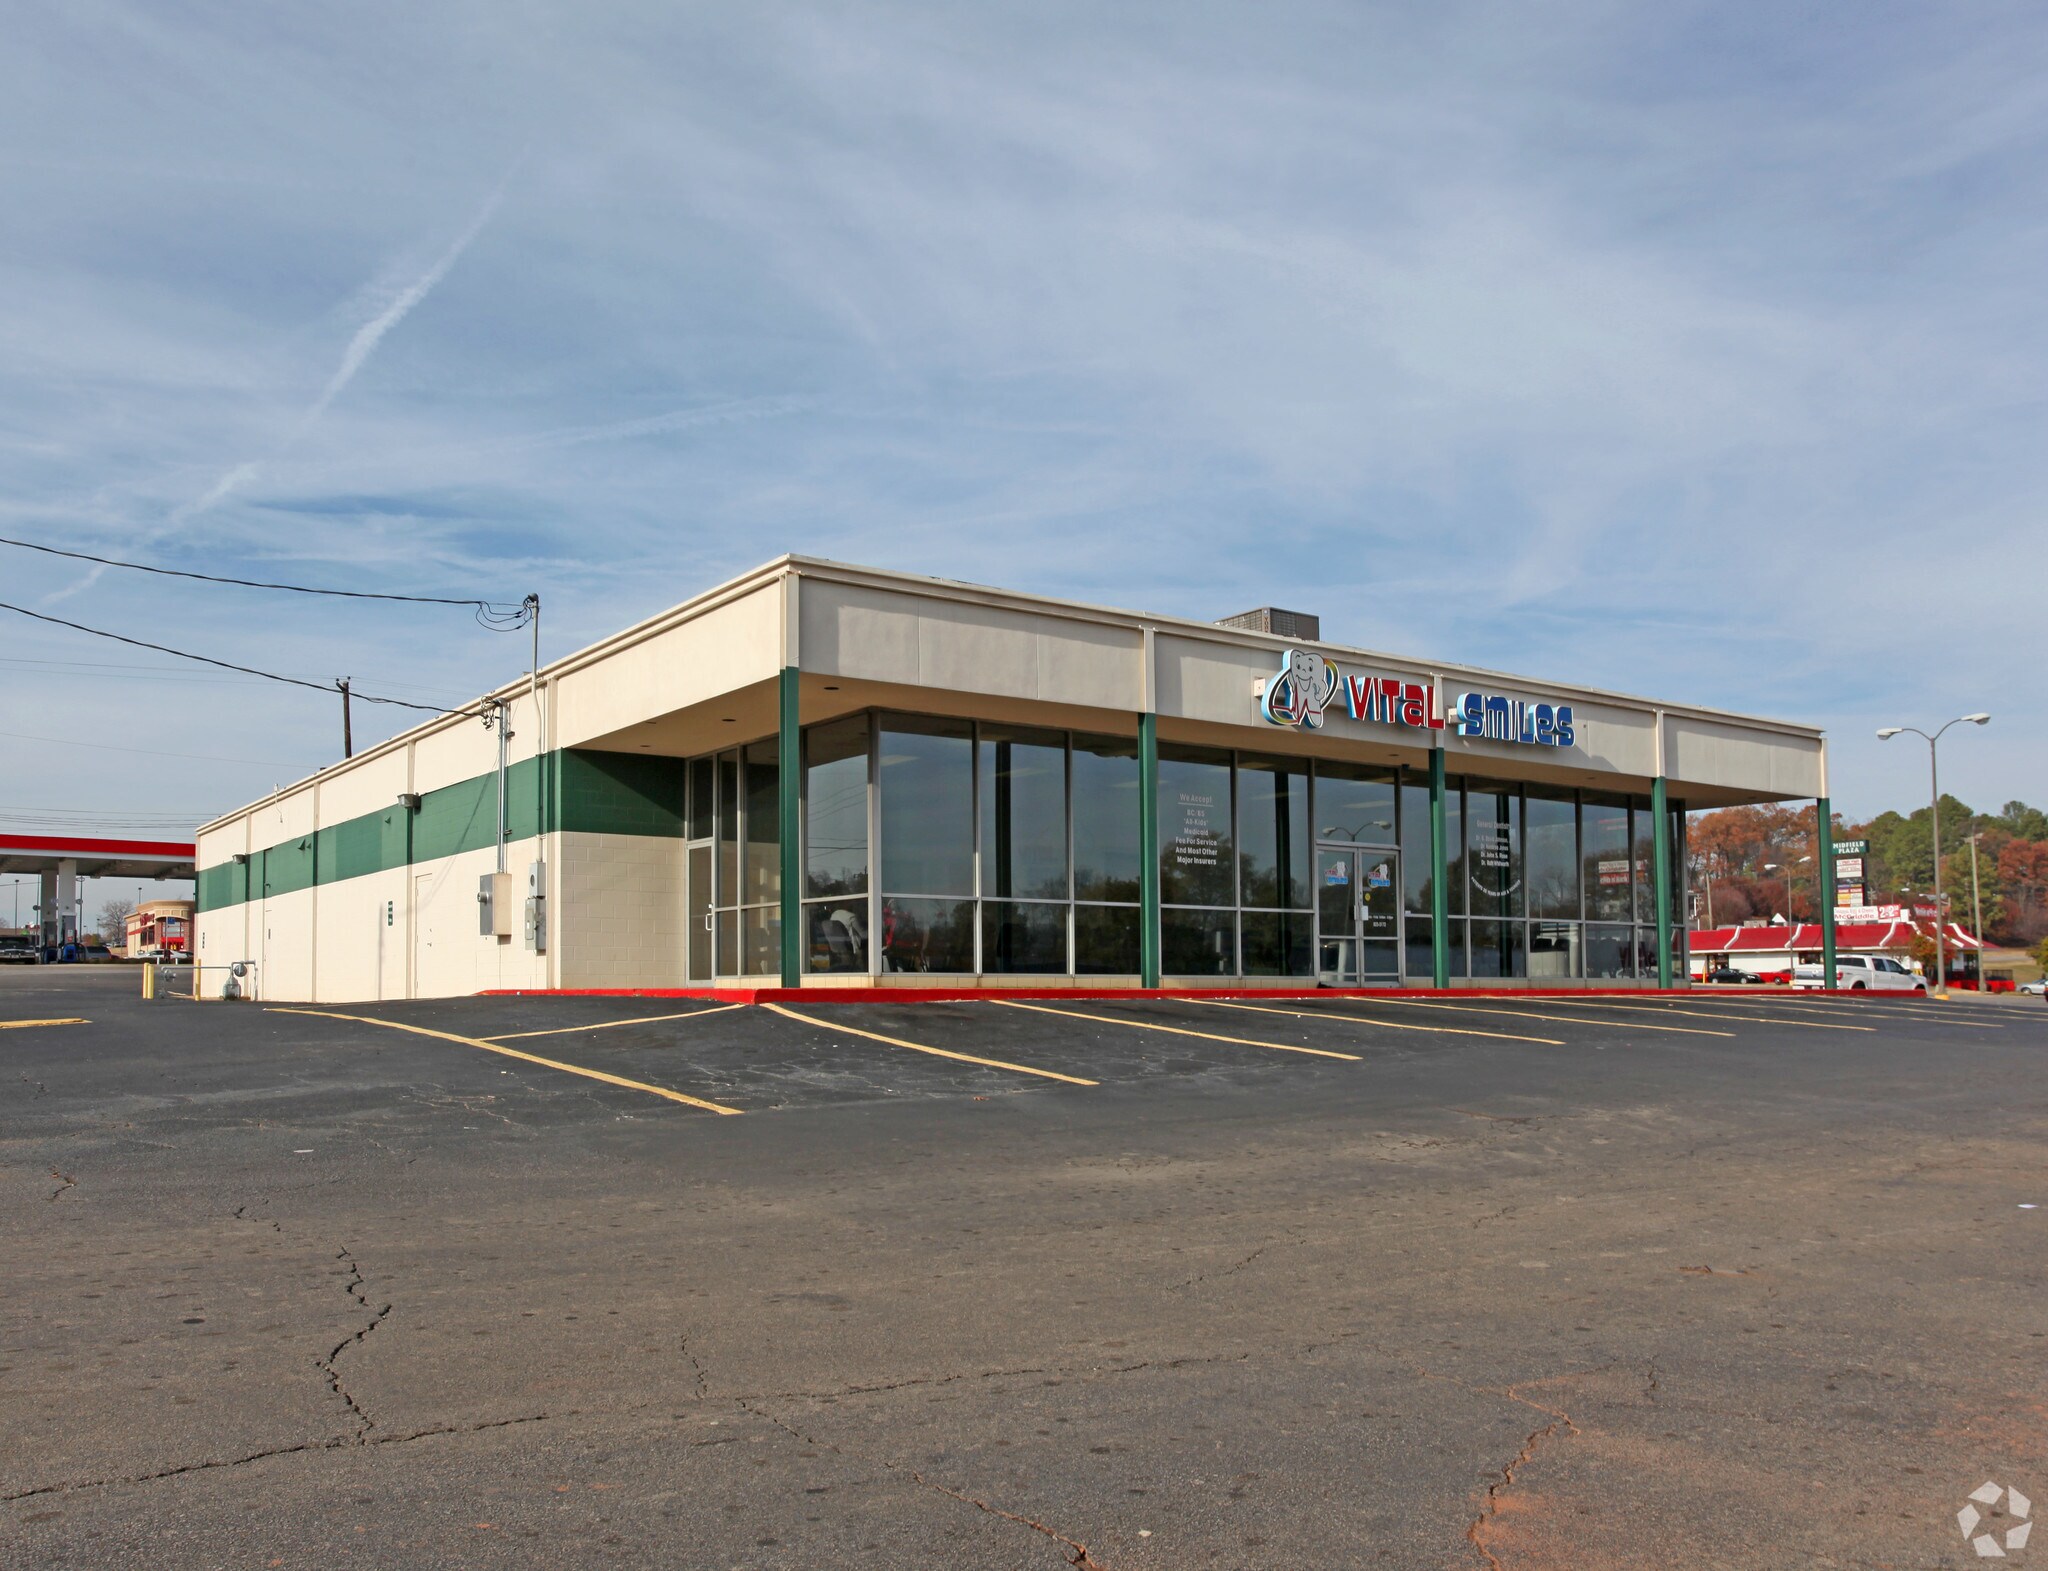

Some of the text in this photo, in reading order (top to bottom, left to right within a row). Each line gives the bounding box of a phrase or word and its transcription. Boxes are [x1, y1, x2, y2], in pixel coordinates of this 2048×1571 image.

[1190, 794, 1212, 804] Accept
[1184, 827, 1209, 836] Medicaid
[1175, 836, 1218, 846] Fee For Service
[1832, 840, 1865, 849] MIDFIELD
[1175, 846, 1218, 856] And Most Other
[1177, 856, 1217, 865] Major Insurers
[1834, 912, 1875, 920] McGriddle
